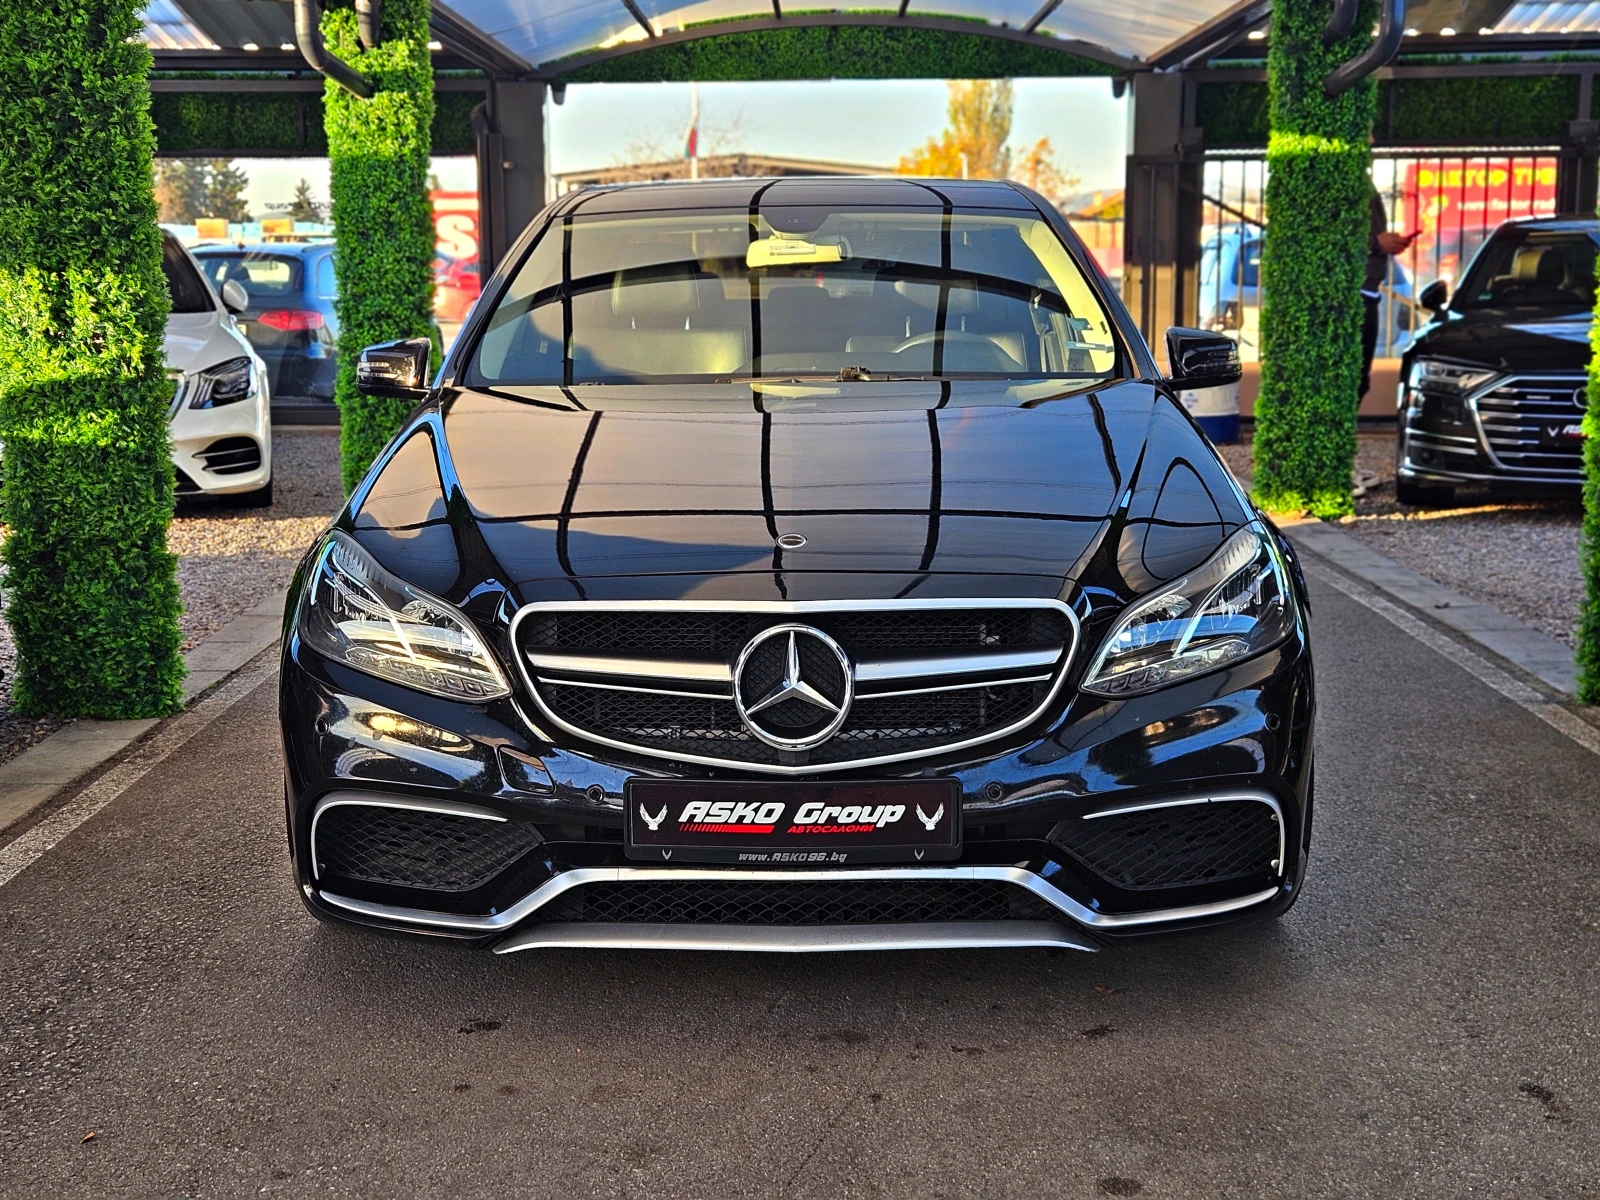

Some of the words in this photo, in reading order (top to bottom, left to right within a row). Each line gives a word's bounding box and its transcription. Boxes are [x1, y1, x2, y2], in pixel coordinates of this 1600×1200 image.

[678, 801, 785, 823] ASKO
[793, 802, 906, 827] Group
[787, 824, 875, 833] АВТОСАЛОНИ
[738, 852, 848, 862] www.ASKO96.bg
